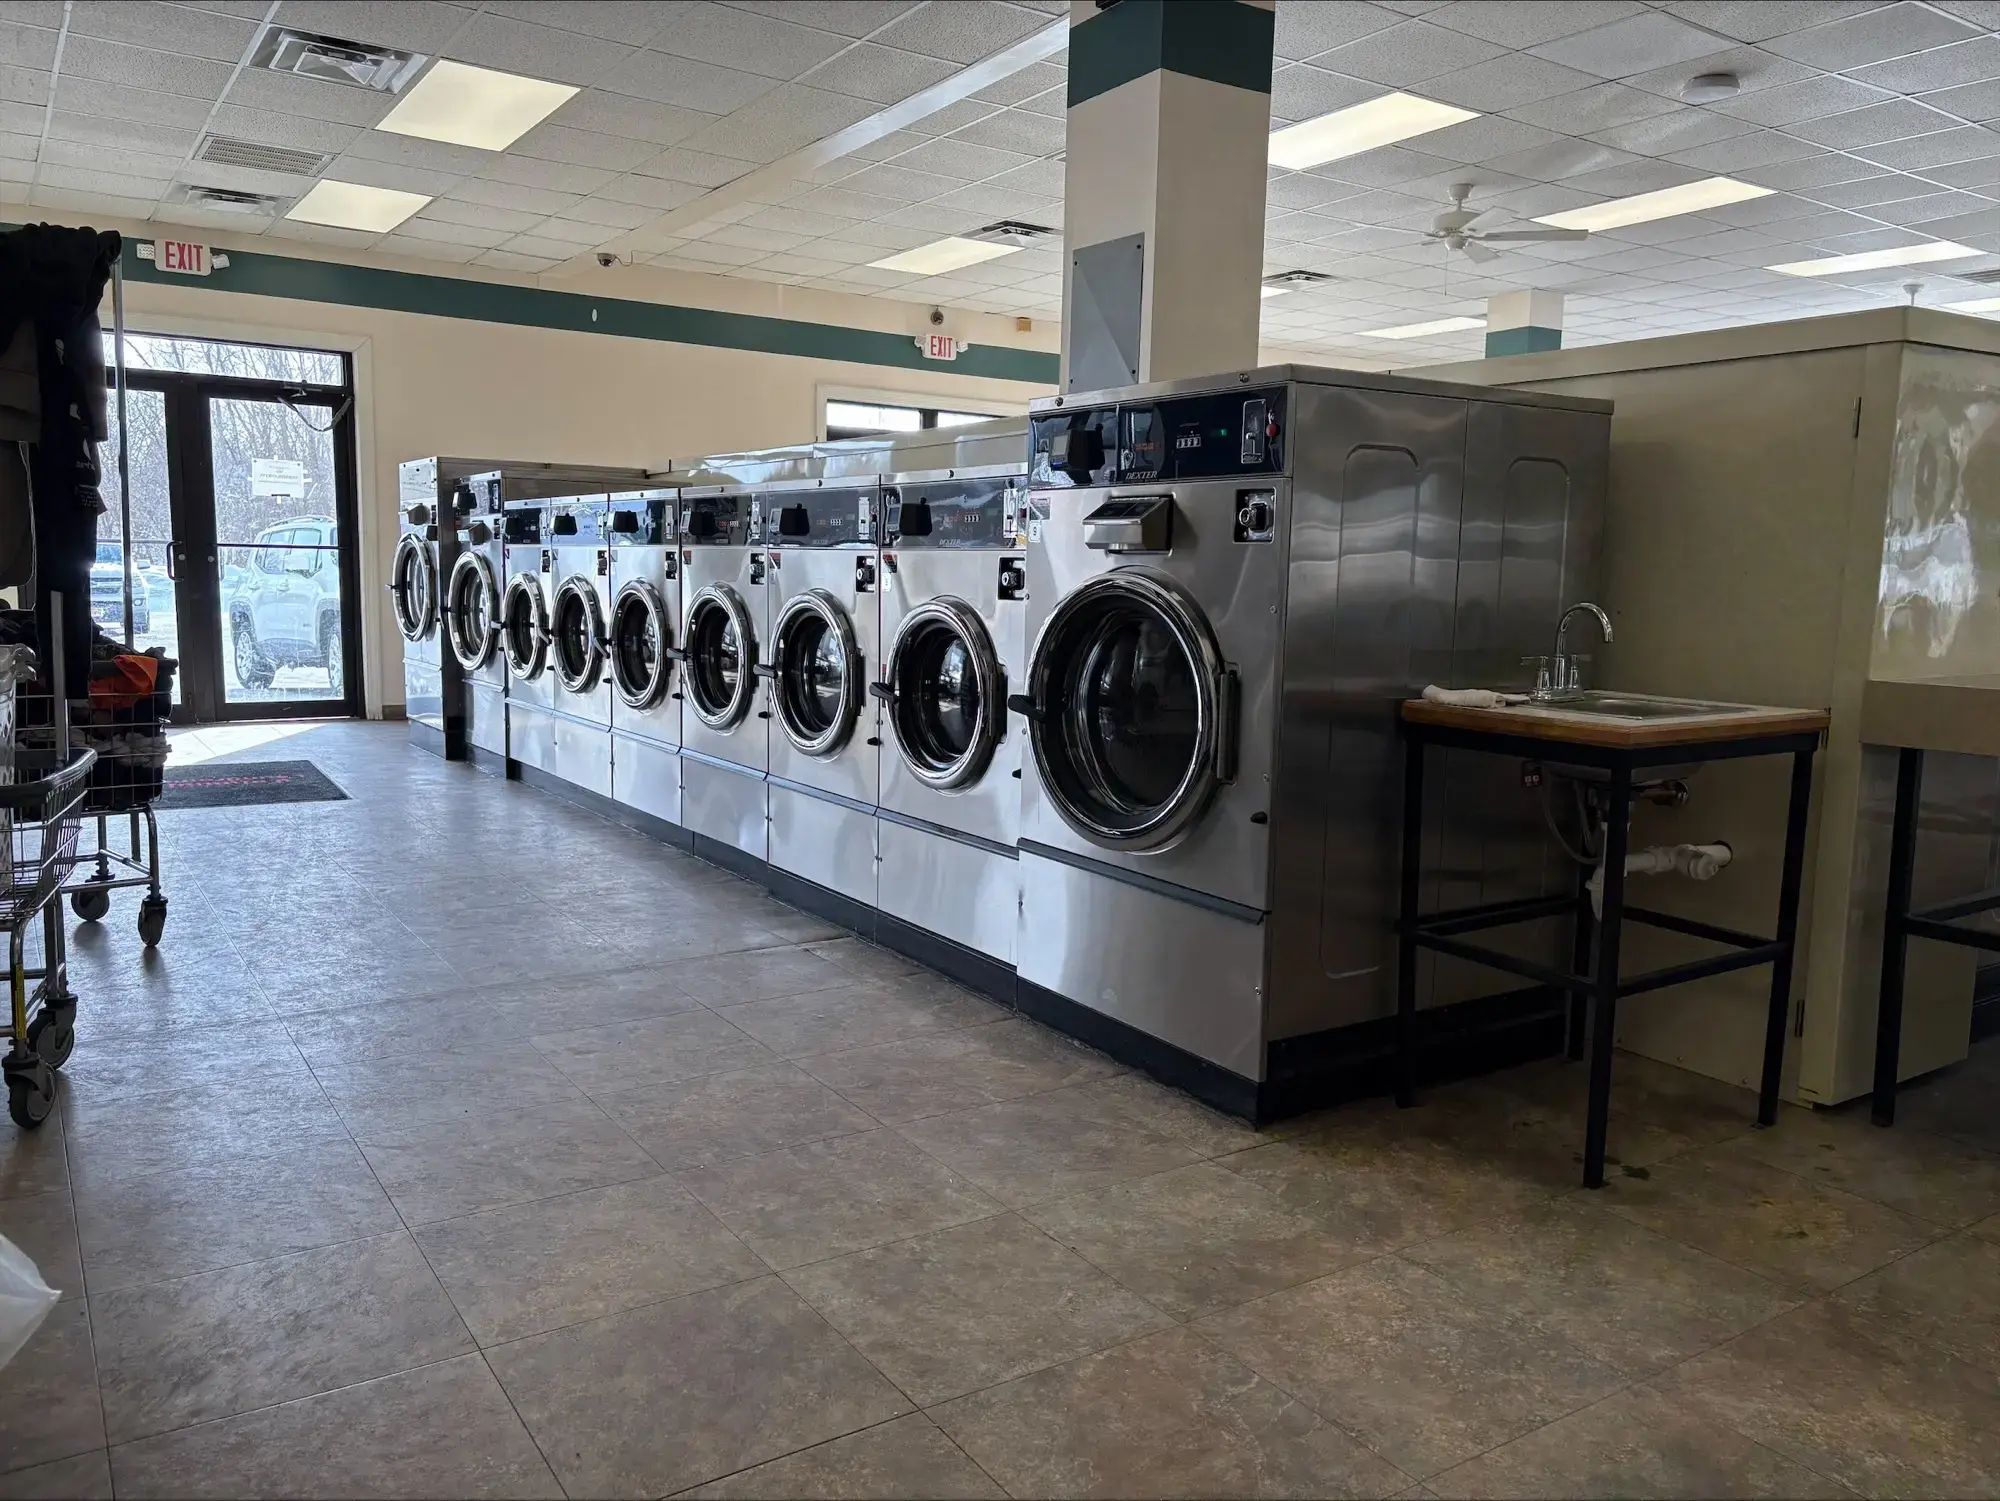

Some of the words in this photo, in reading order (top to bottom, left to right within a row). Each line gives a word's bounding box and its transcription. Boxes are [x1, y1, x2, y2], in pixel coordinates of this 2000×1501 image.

[165, 241, 203, 272] EXIT
[930, 335, 953, 358] EXIT
[1125, 470, 1158, 480] DEXTER
